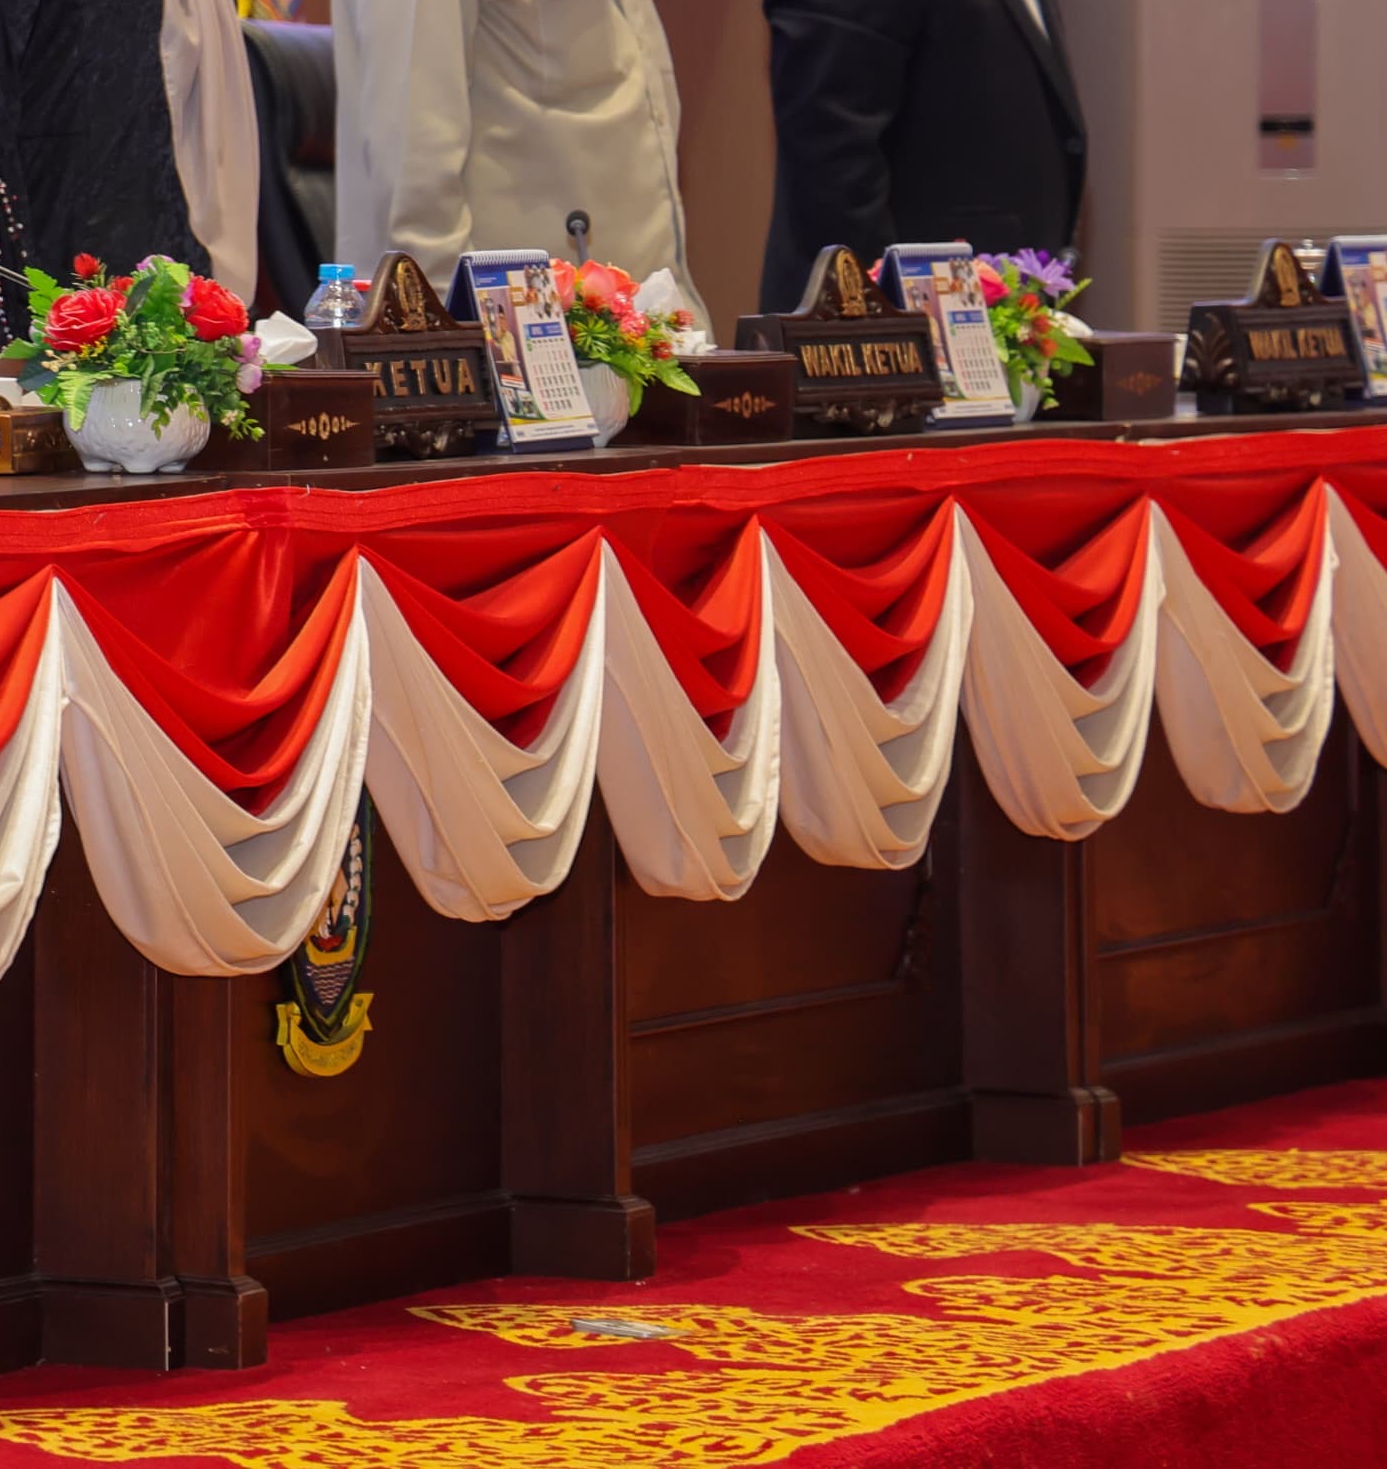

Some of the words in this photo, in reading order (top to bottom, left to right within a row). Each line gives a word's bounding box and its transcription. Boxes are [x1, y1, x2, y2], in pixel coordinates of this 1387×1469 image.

[364, 358, 476, 397] KETUA
[799, 343, 862, 377] WAKIL
[860, 341, 924, 375] KETUA
